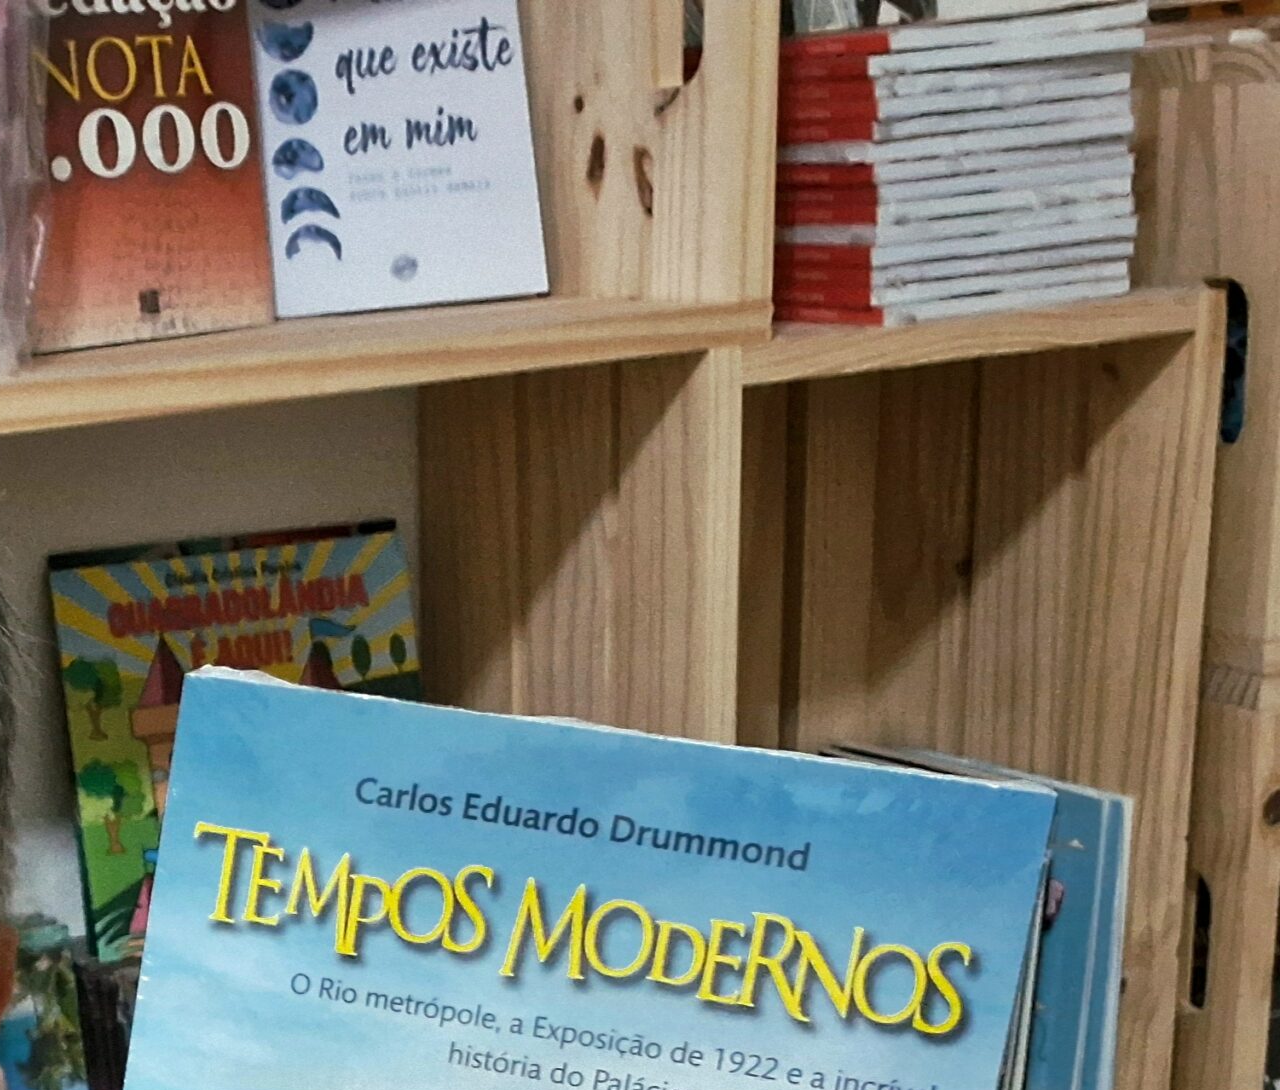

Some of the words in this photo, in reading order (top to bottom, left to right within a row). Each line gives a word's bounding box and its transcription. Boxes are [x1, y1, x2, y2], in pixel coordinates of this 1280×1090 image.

[32, 34, 214, 102] NOTA
[335, 45, 397, 95] que
[411, 16, 514, 76] existe
[343, 121, 392, 156] em
[405, 106, 478, 150] mim
[355, 777, 453, 817] Carlos
[462, 792, 599, 838] Eduardo
[609, 814, 811, 871] Drummond
[193, 820, 495, 957] TEMPOS
[498, 875, 972, 1035] MODERNOS
[290, 972, 311, 995] O
[318, 976, 358, 1004] Rio
[365, 989, 501, 1034] metrópole,
[509, 1017, 524, 1035] a
[532, 1015, 662, 1060] Exposição
[669, 1041, 704, 1067] de
[714, 1047, 779, 1081] 1922
[786, 1067, 803, 1085] e
[810, 1071, 825, 1090] a
[448, 1041, 542, 1081] história
[550, 1062, 584, 1087] do
